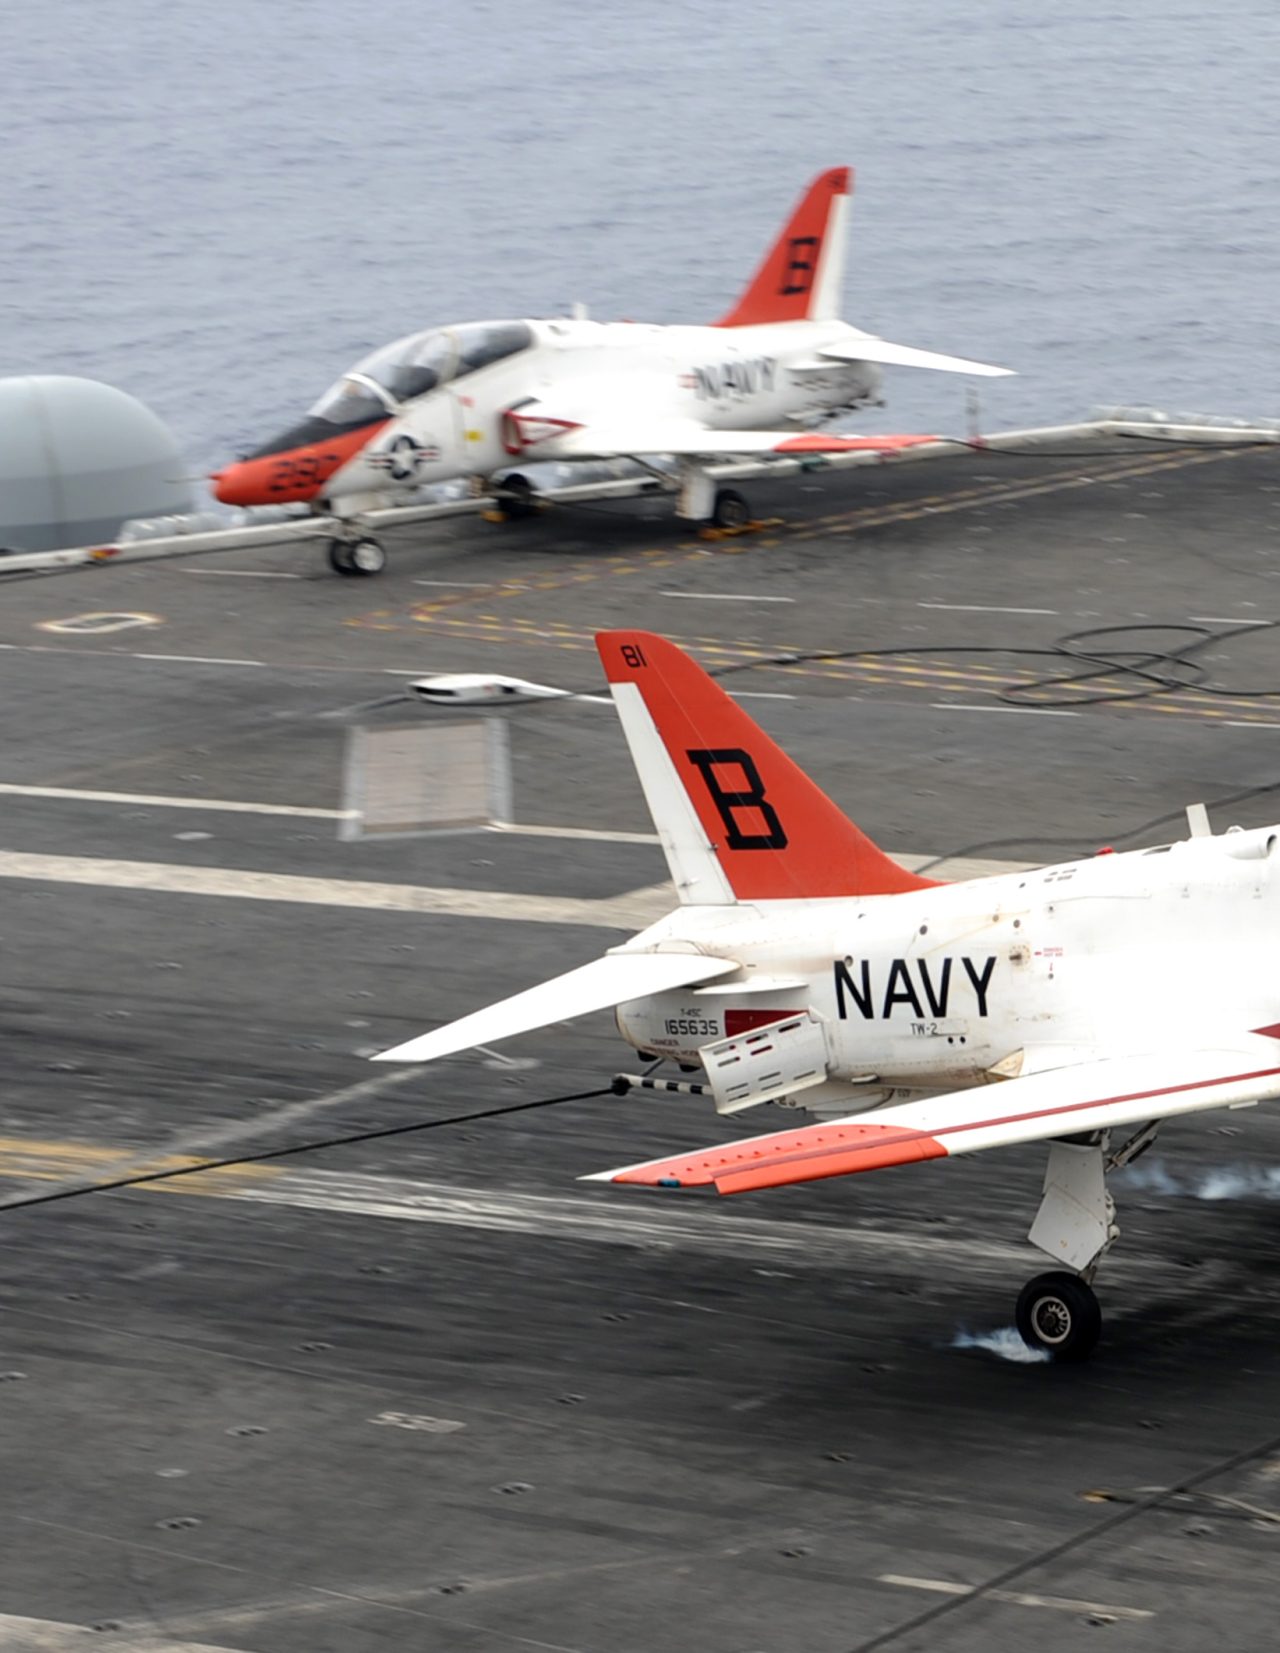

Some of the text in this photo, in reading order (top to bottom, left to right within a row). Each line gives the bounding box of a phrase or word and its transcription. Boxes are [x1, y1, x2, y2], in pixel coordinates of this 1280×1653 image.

[694, 357, 776, 399] NAVY
[620, 645, 647, 668] 81
[686, 748, 788, 850] B
[834, 956, 997, 1020] NAVY
[664, 1019, 719, 1036] 165635
[911, 1023, 938, 1035] TW-2
